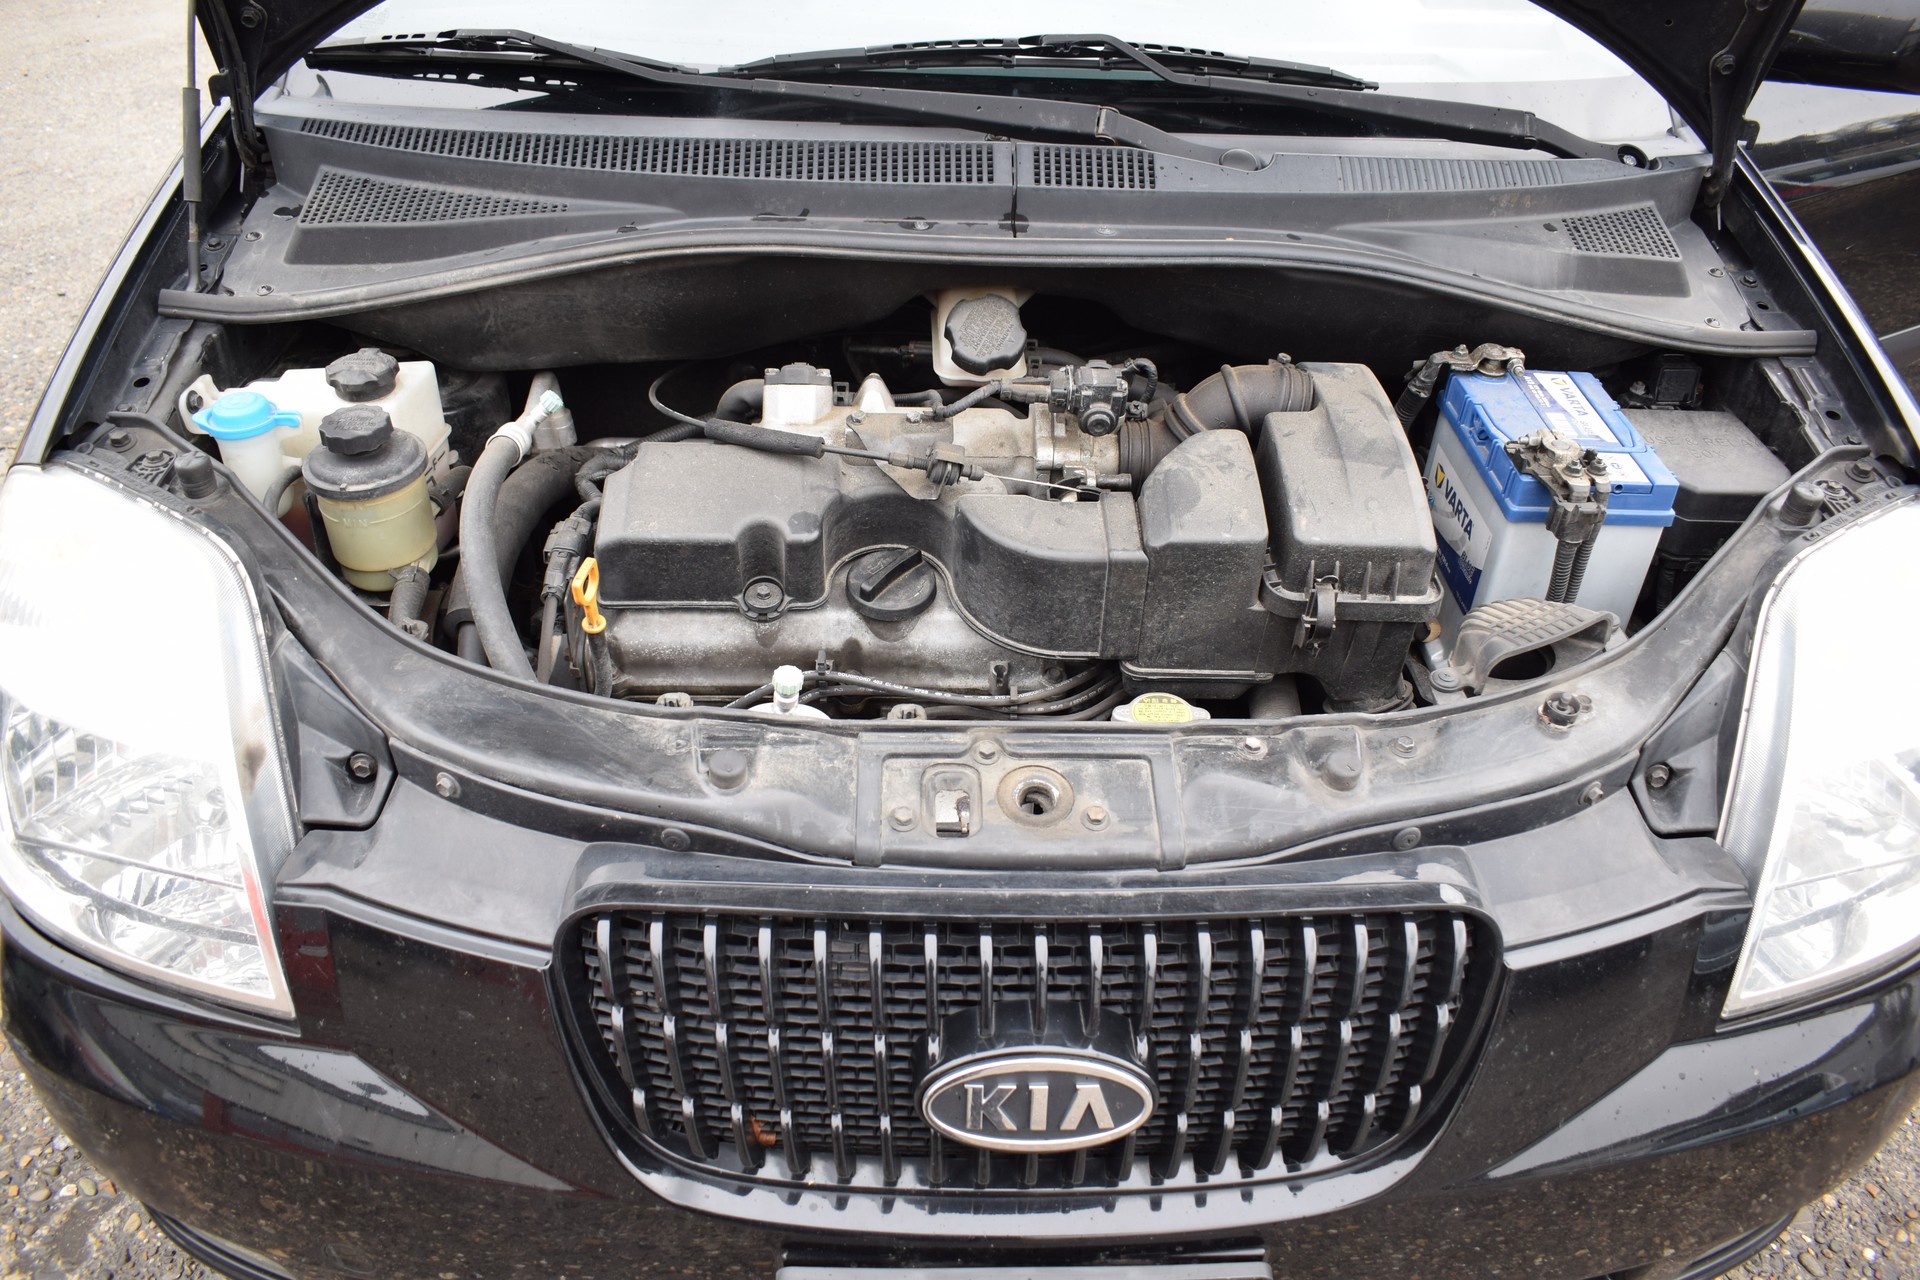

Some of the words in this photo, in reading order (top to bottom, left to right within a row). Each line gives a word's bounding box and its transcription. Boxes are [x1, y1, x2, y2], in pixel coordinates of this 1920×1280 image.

[1559, 386, 1589, 417] VARTA
[1644, 433, 1680, 446] USE
[1688, 448, 1727, 460] BOX
[1444, 477, 1474, 541] VARTA
[964, 1083, 1115, 1131] KIA
